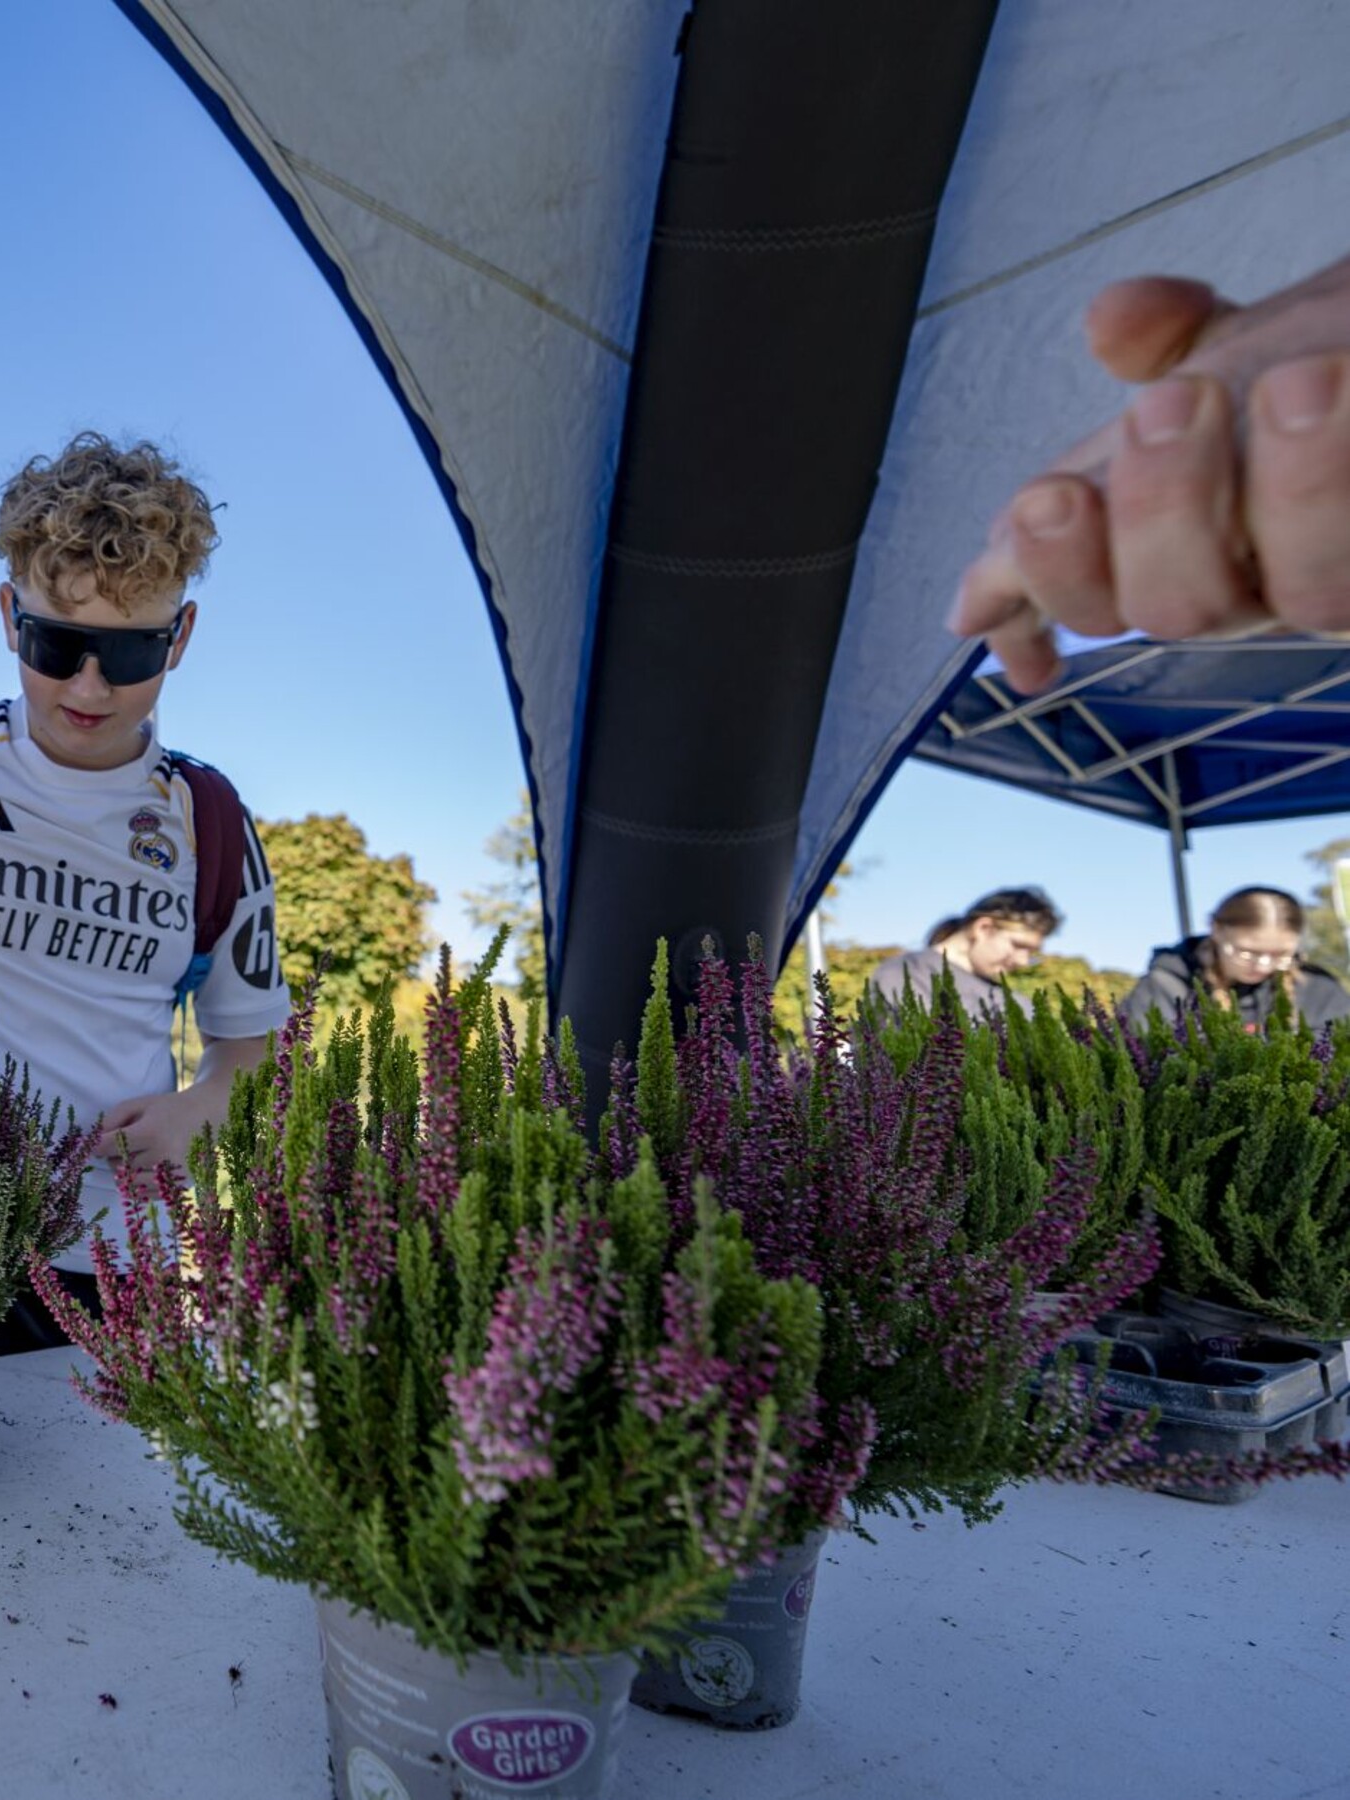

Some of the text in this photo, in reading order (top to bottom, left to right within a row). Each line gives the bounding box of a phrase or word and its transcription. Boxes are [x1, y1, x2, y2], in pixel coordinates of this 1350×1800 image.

[47, 919, 160, 975] BETTER
[470, 1723, 575, 1752] Garden
[493, 1749, 561, 1778] Girls
